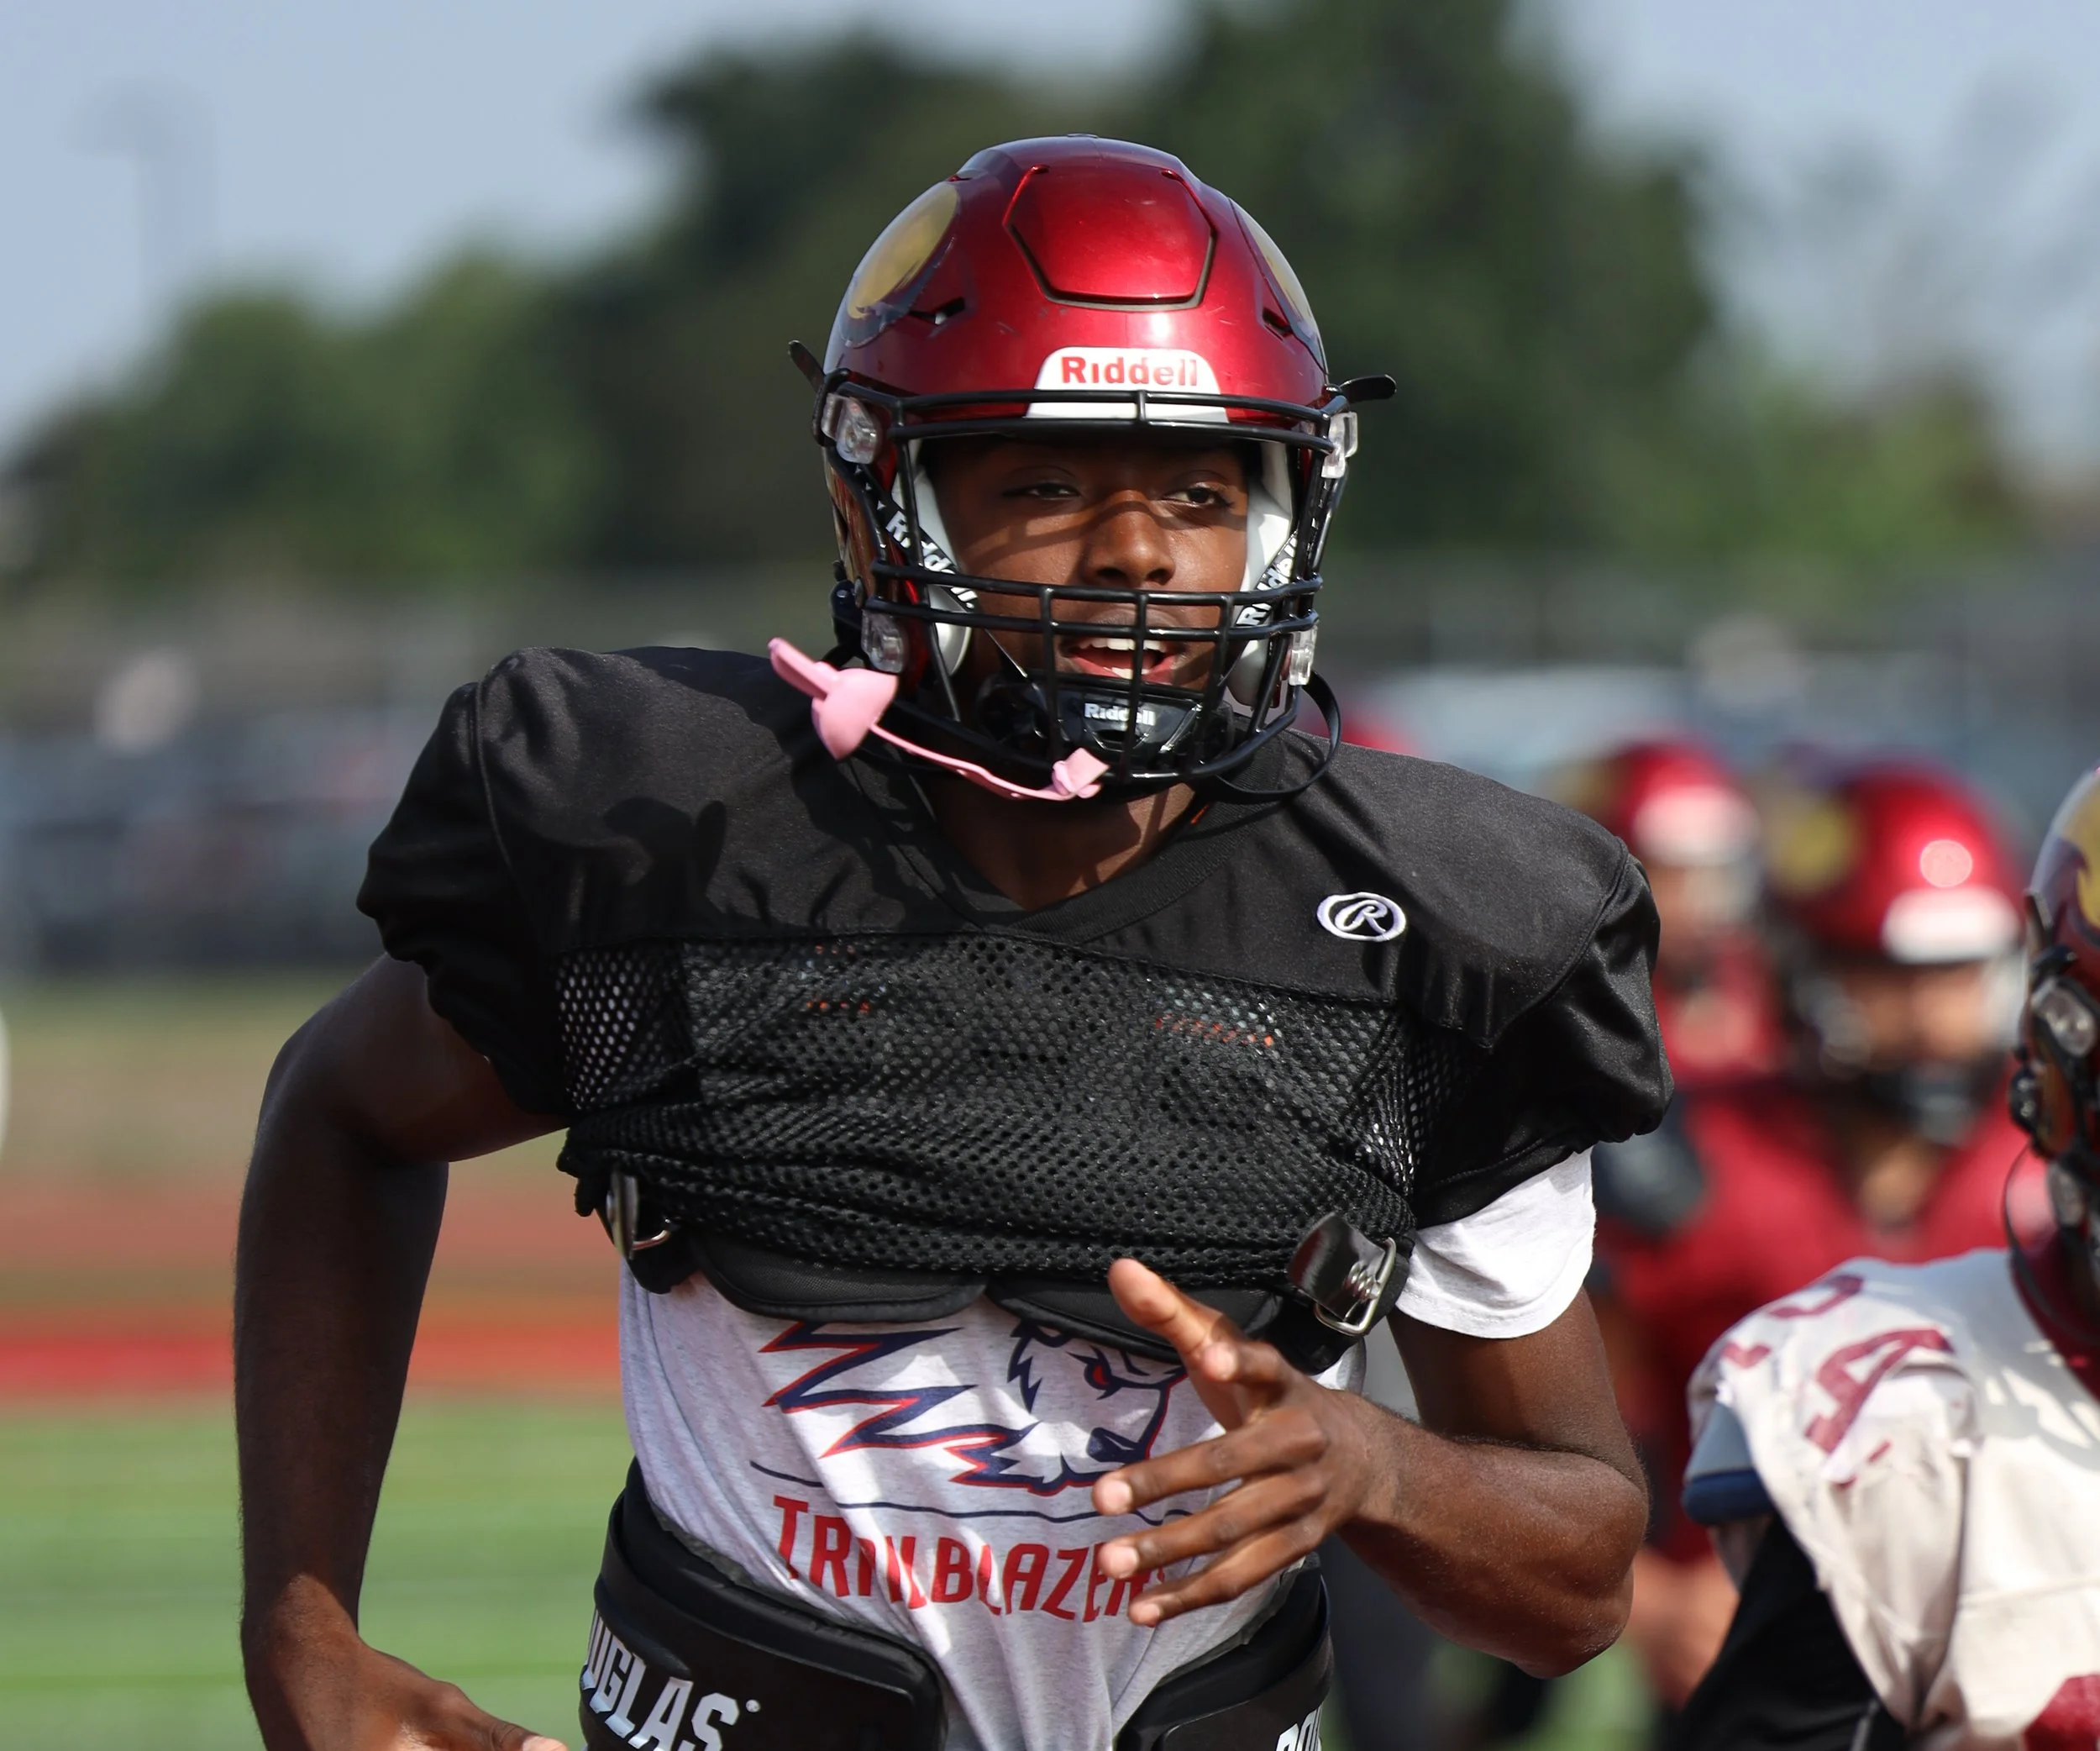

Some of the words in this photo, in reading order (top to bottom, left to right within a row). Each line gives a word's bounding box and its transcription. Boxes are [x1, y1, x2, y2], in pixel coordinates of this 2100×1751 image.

[1061, 355, 1198, 386] Riddell
[774, 1495, 1166, 1627] TRAILBLAZER
[580, 1608, 740, 1751] UGLAS
